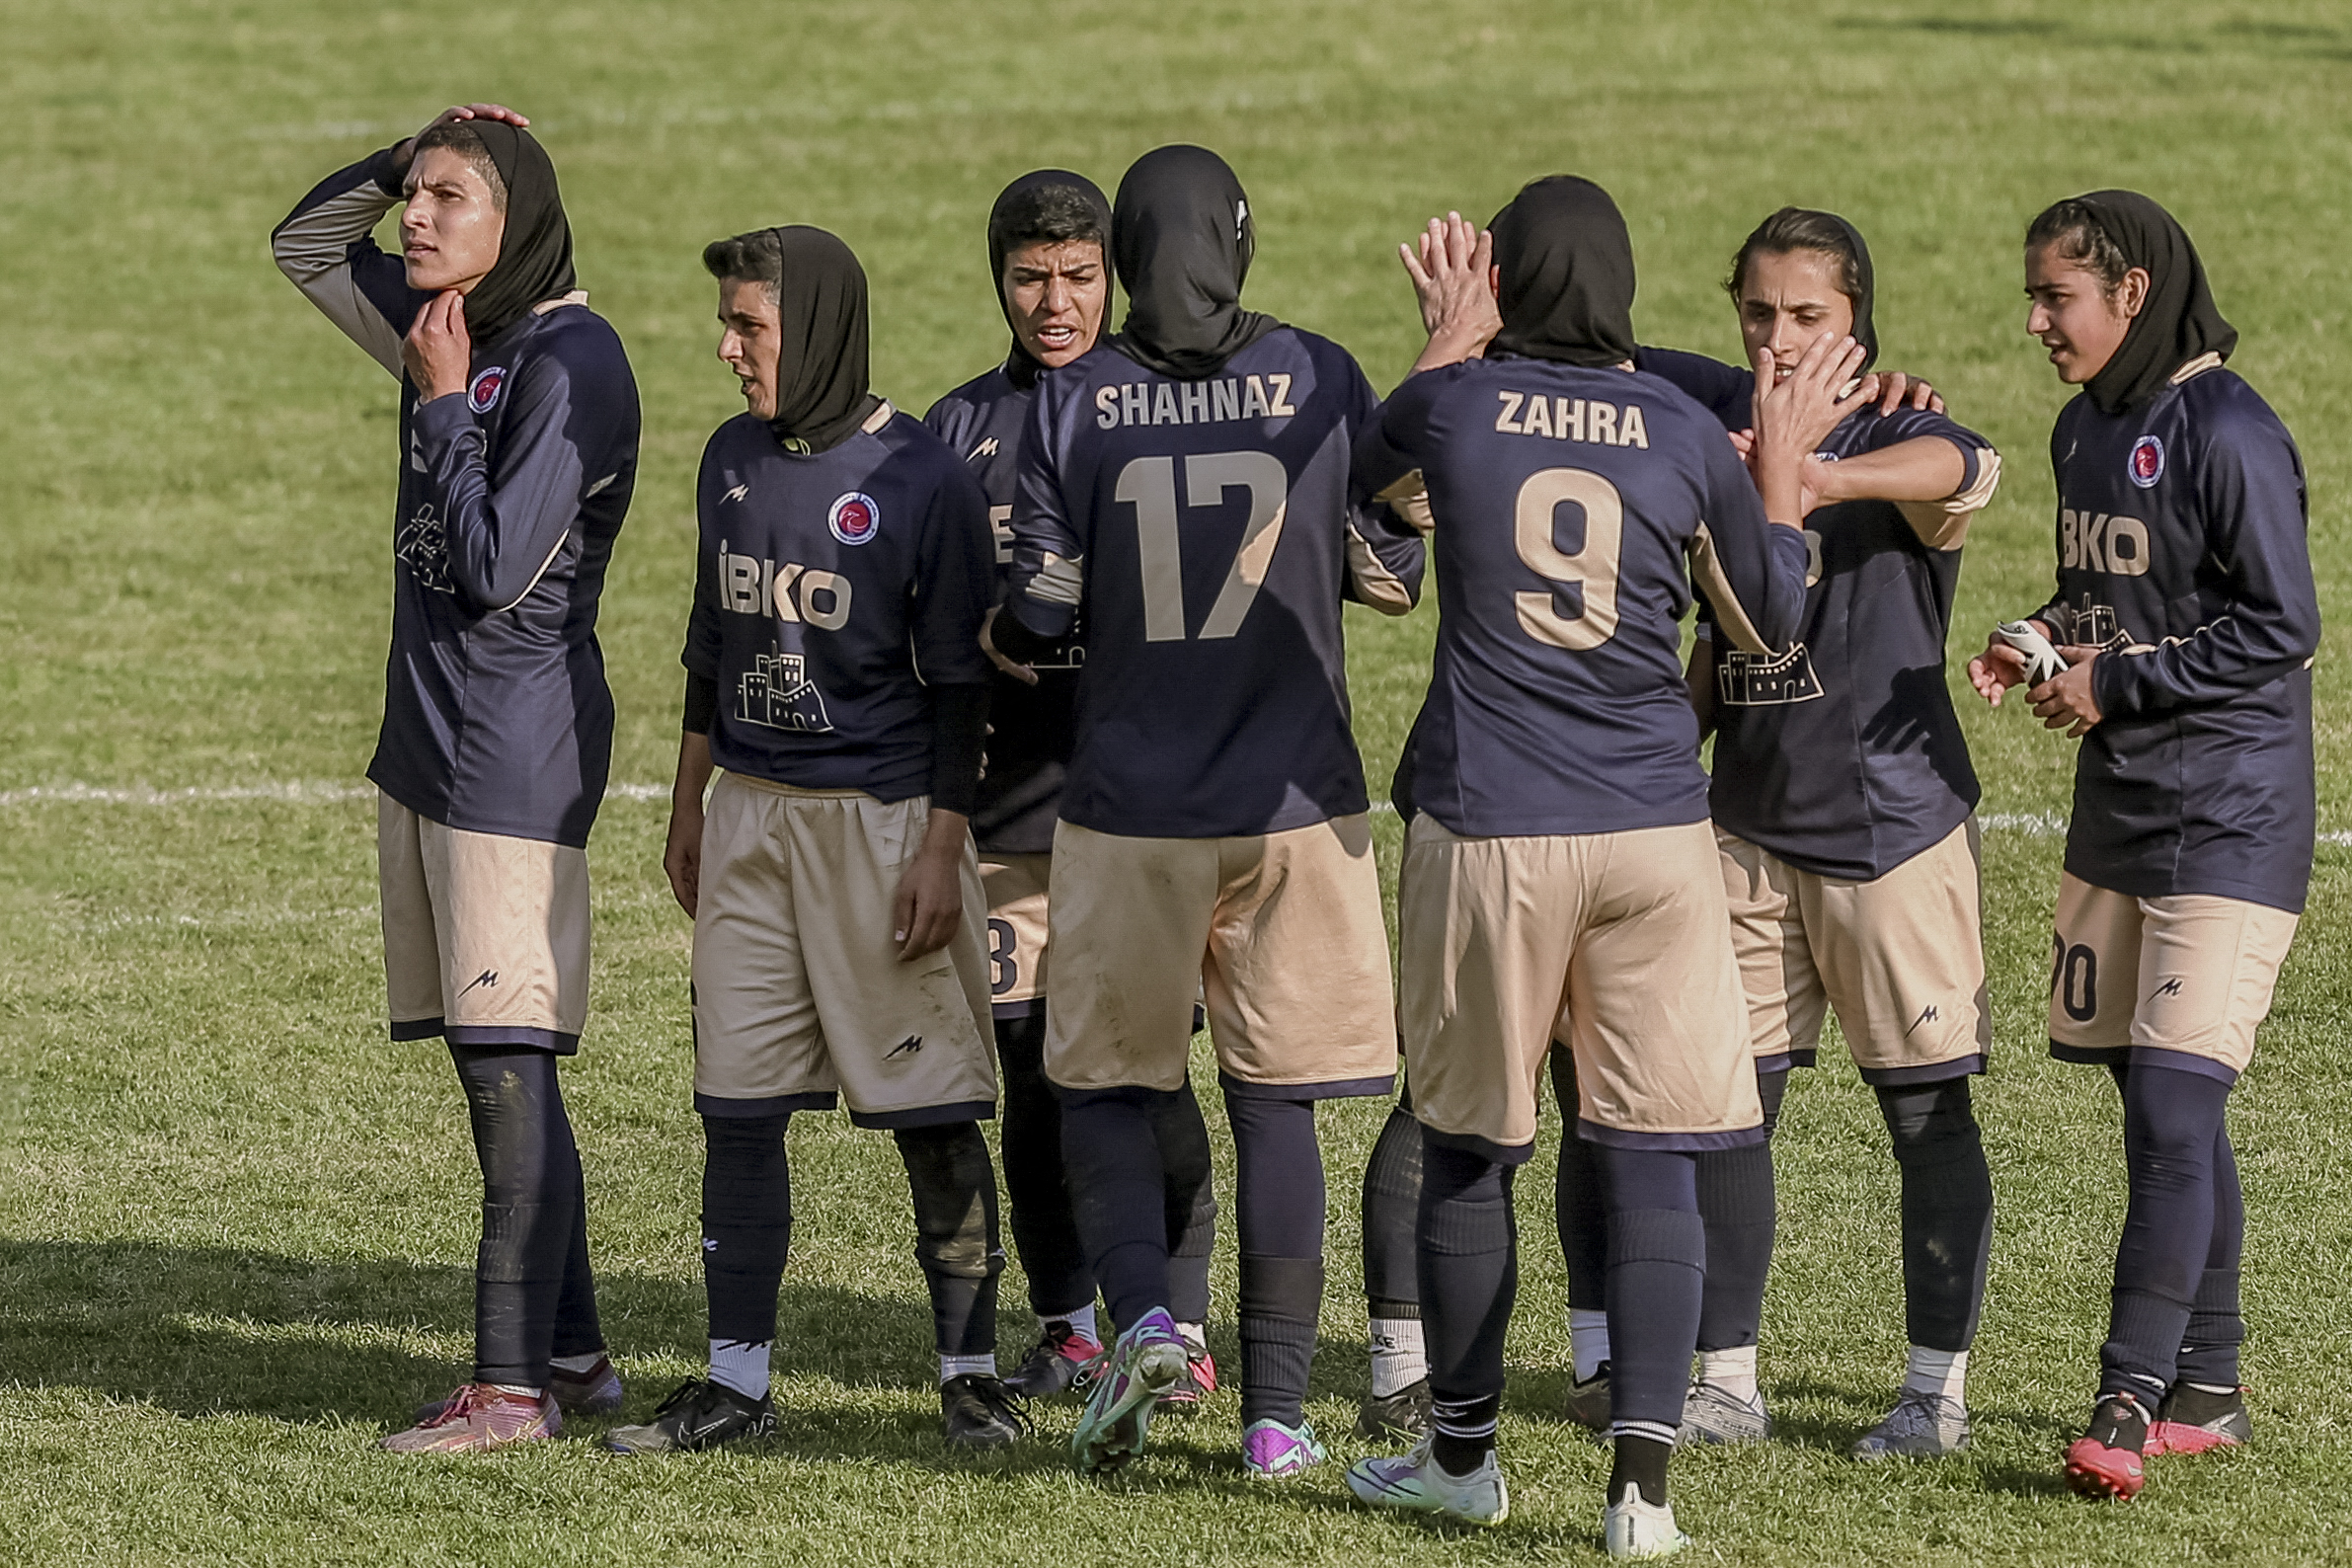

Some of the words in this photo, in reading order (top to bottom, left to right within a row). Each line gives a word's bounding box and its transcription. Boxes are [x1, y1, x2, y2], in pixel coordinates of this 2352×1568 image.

[1095, 373, 1295, 431] SHAHNAZ
[1495, 390, 1650, 450] ZAHRA
[1115, 450, 1288, 642] 17
[1515, 466, 1623, 652] 9
[2062, 496, 2151, 577] BKO
